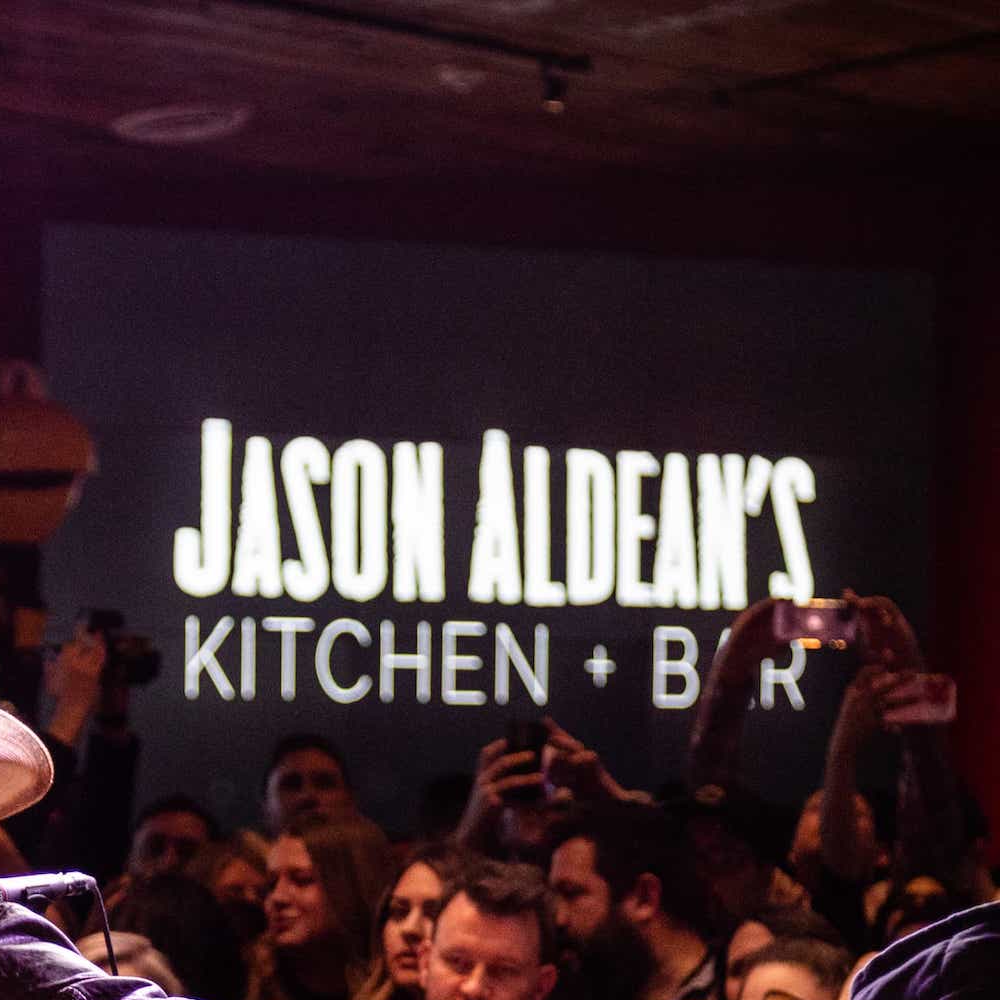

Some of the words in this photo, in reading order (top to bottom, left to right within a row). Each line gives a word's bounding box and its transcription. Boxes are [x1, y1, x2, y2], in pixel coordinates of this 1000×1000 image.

[173, 417, 446, 602] JASON
[467, 428, 816, 610] ALDEAN'S
[184, 614, 549, 706] KITCHEN
[652, 624, 807, 711] BR
